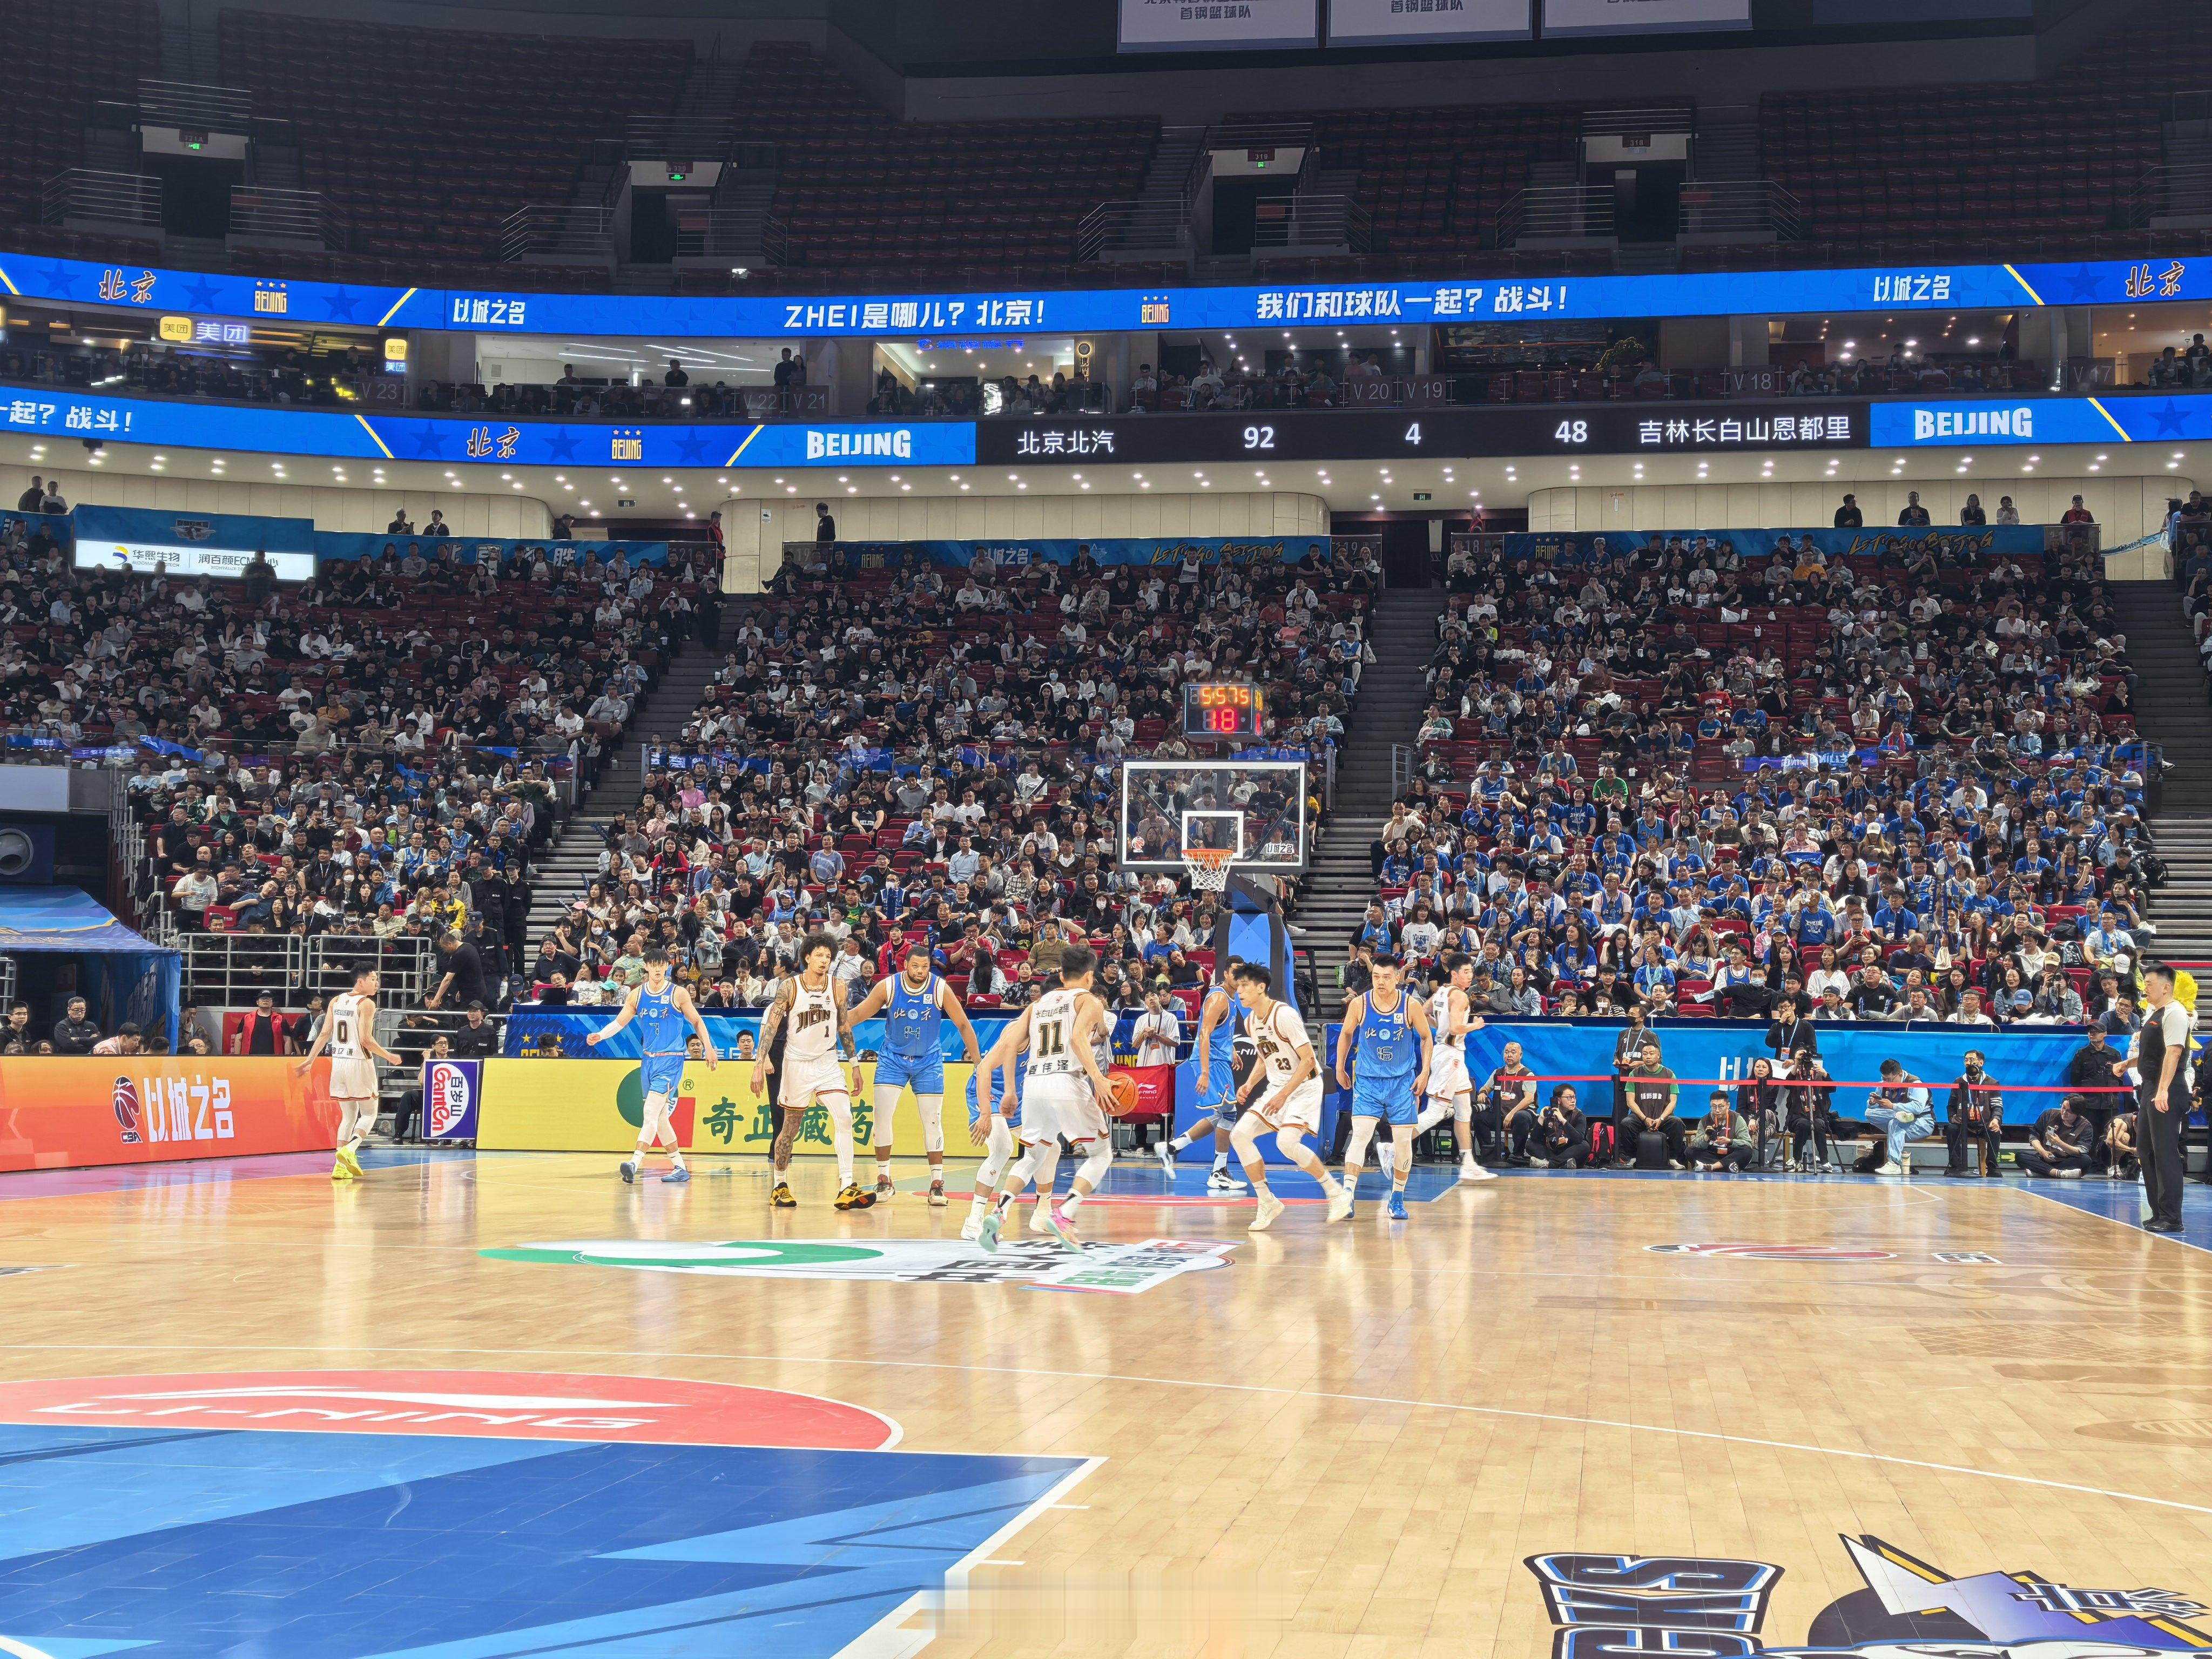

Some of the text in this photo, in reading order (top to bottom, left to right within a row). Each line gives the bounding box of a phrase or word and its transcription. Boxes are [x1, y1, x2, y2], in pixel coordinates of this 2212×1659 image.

[1181, 5, 1251, 20] 首钢篮球队
[99, 269, 157, 304] 北京
[1873, 274, 1950, 302] 以城之名
[2124, 260, 2186, 298] 北京
[254, 290, 287, 313] BEIJING
[453, 298, 525, 325] 以城之名
[1257, 286, 1567, 319] 我们和球队一起? 战斗!
[976, 300, 1044, 326] 北京!
[1141, 302, 1170, 324] BEIJING
[163, 324, 188, 334] 美团
[195, 322, 249, 343] 美团
[387, 345, 406, 355] 美团
[385, 361, 406, 373] 美团
[2073, 365, 2112, 383] V 17
[376, 383, 397, 400] 23
[1354, 384, 1390, 400] V 20
[1407, 381, 1443, 399] V 19
[1734, 372, 1772, 391] V 18
[757, 394, 777, 409] 22
[793, 393, 825, 409] V 21
[0, 400, 132, 433] 起? 战斗!
[1914, 407, 2032, 440] BEIJING
[1244, 426, 1274, 448] 92
[1405, 423, 1421, 445] 4
[1555, 421, 1587, 442] 48
[1638, 416, 1851, 443] 吉林长白山恩都里
[467, 426, 521, 459] 北京
[612, 439, 642, 460] BEIJING
[807, 430, 911, 460] BEIJING
[1017, 430, 1115, 454] 北京北汽
[132, 550, 279, 568] 华熙生物 润百颜ECM心
[1211, 709, 1235, 731] 18
[1267, 844, 1294, 854] 以城之名
[337, 1020, 348, 1044] 0
[649, 1022, 659, 1035] 7
[824, 1025, 830, 1037] 1
[904, 1026, 920, 1040] 14
[1037, 1019, 1064, 1058] 11
[1275, 1057, 1292, 1070] 23
[450, 1076, 463, 1117] 百岁山
[143, 1074, 234, 1143] 以城之名
[29, 1401, 660, 1430] LI-NING
